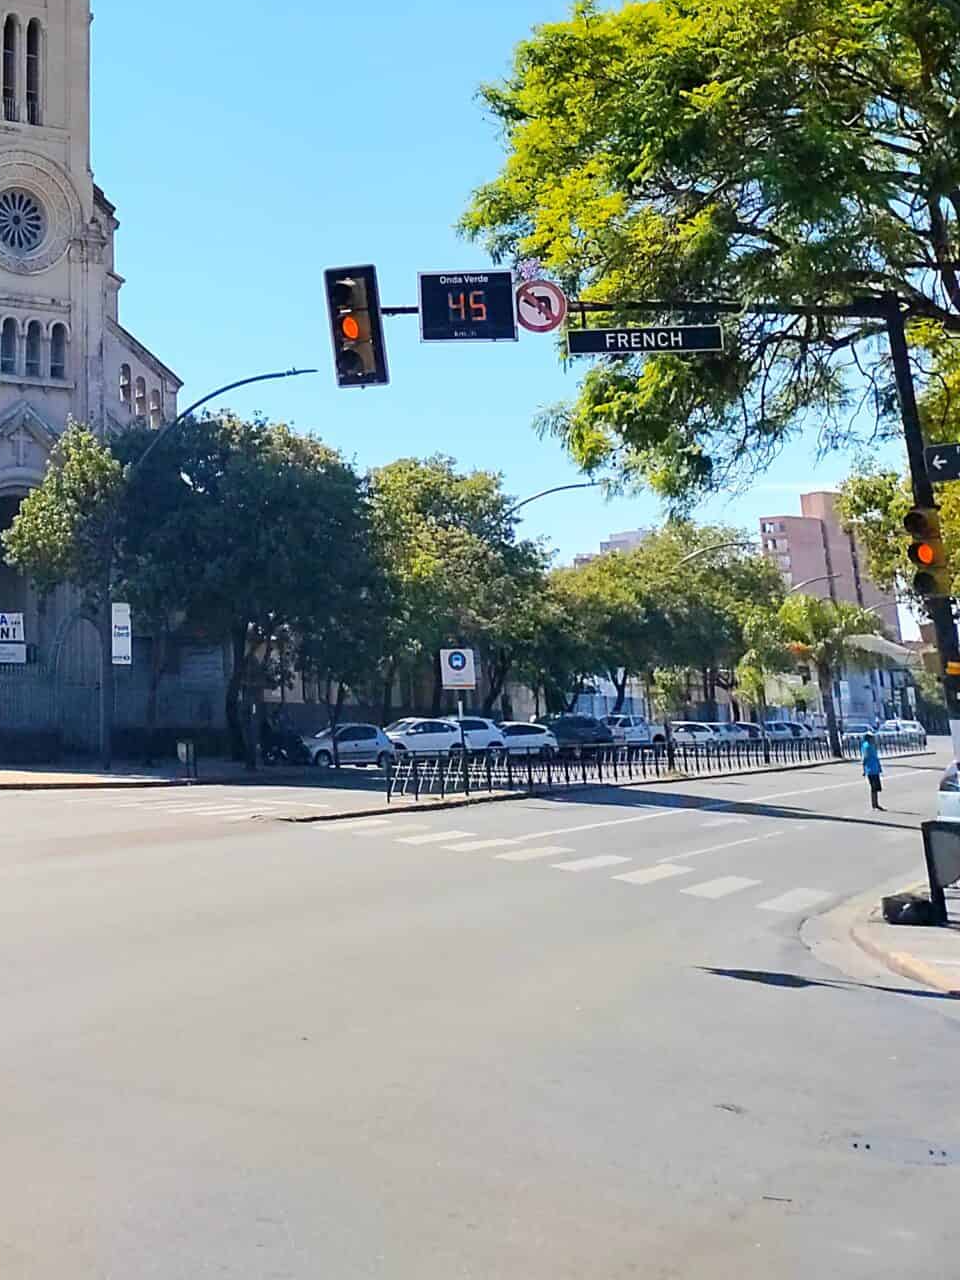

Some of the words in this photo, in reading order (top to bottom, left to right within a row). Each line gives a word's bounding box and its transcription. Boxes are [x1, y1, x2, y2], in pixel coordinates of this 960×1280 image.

[440, 276, 462, 285] Onda
[463, 274, 489, 284] Verde
[448, 291, 487, 321] 45
[605, 331, 683, 348] FRENCH
